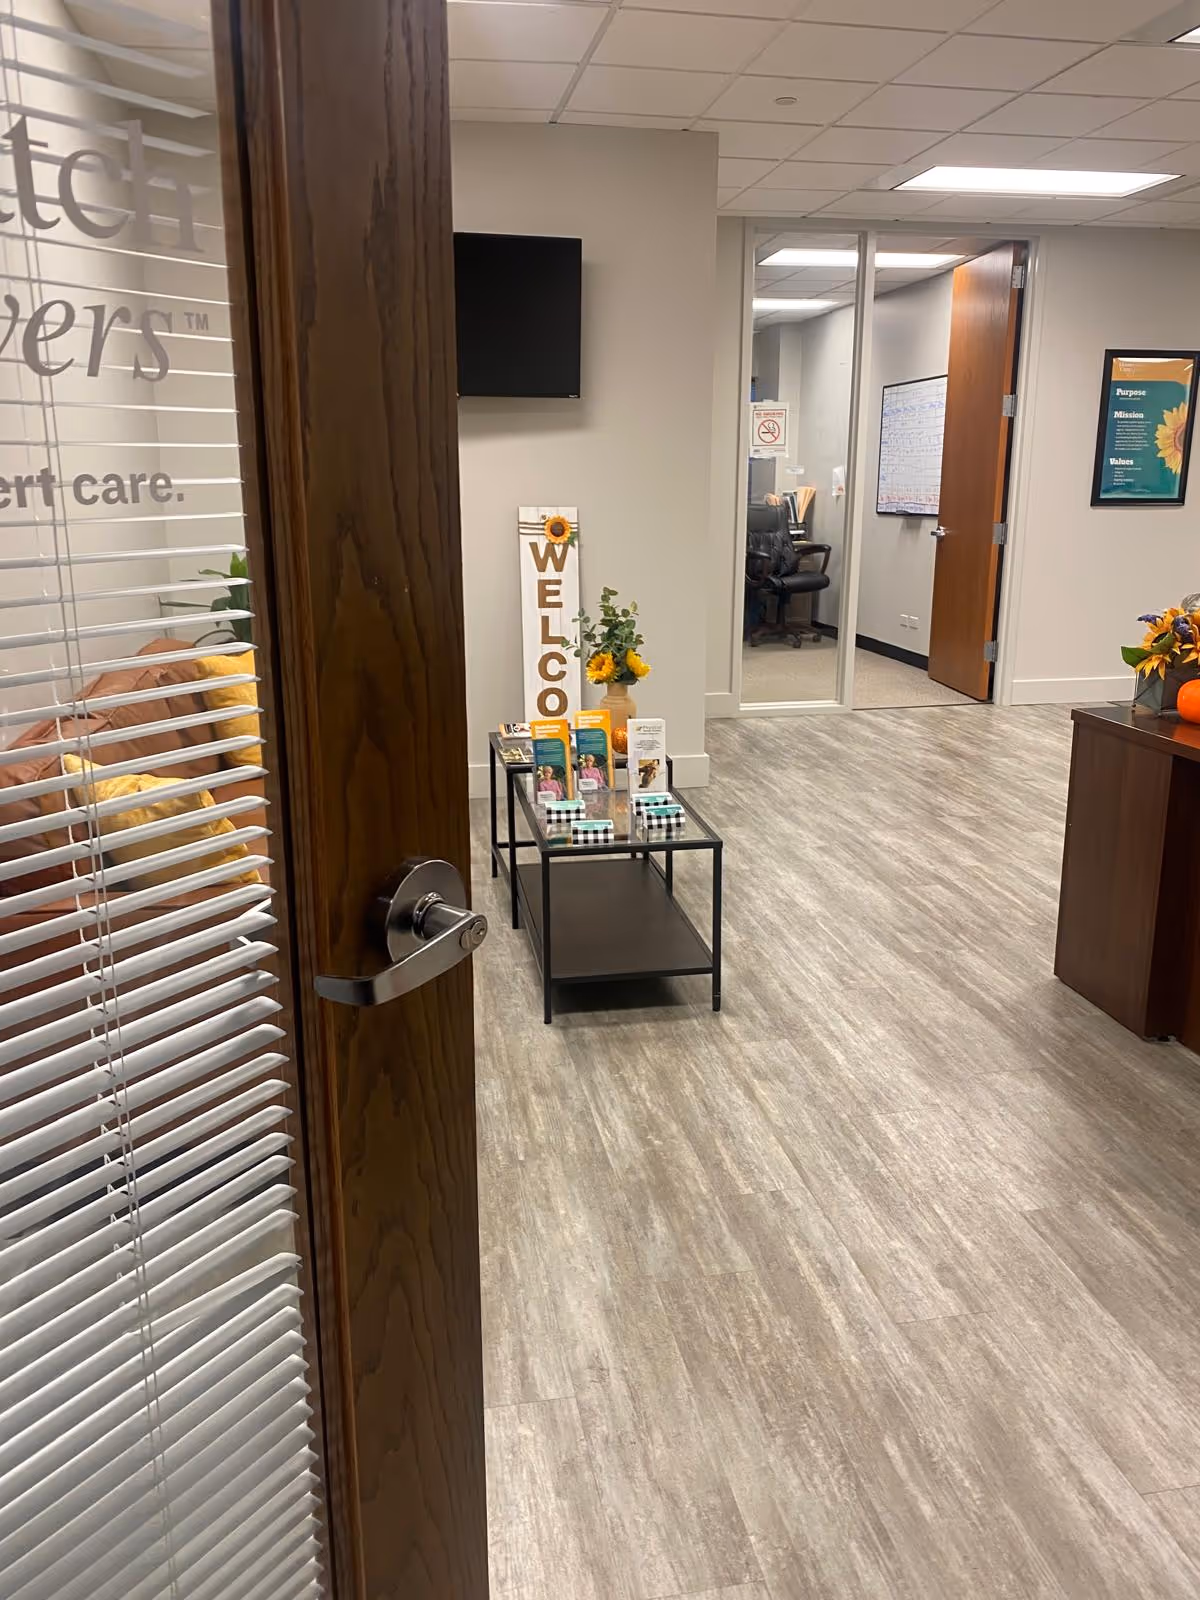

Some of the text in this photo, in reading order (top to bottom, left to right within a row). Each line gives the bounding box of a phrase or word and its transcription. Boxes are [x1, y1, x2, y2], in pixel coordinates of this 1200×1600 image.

[0, 115, 206, 253] tch
[1116, 388, 1147, 397] Purpose
[1113, 410, 1144, 418] Mission
[1109, 457, 1134, 465] Values
[73, 471, 185, 506] care.
